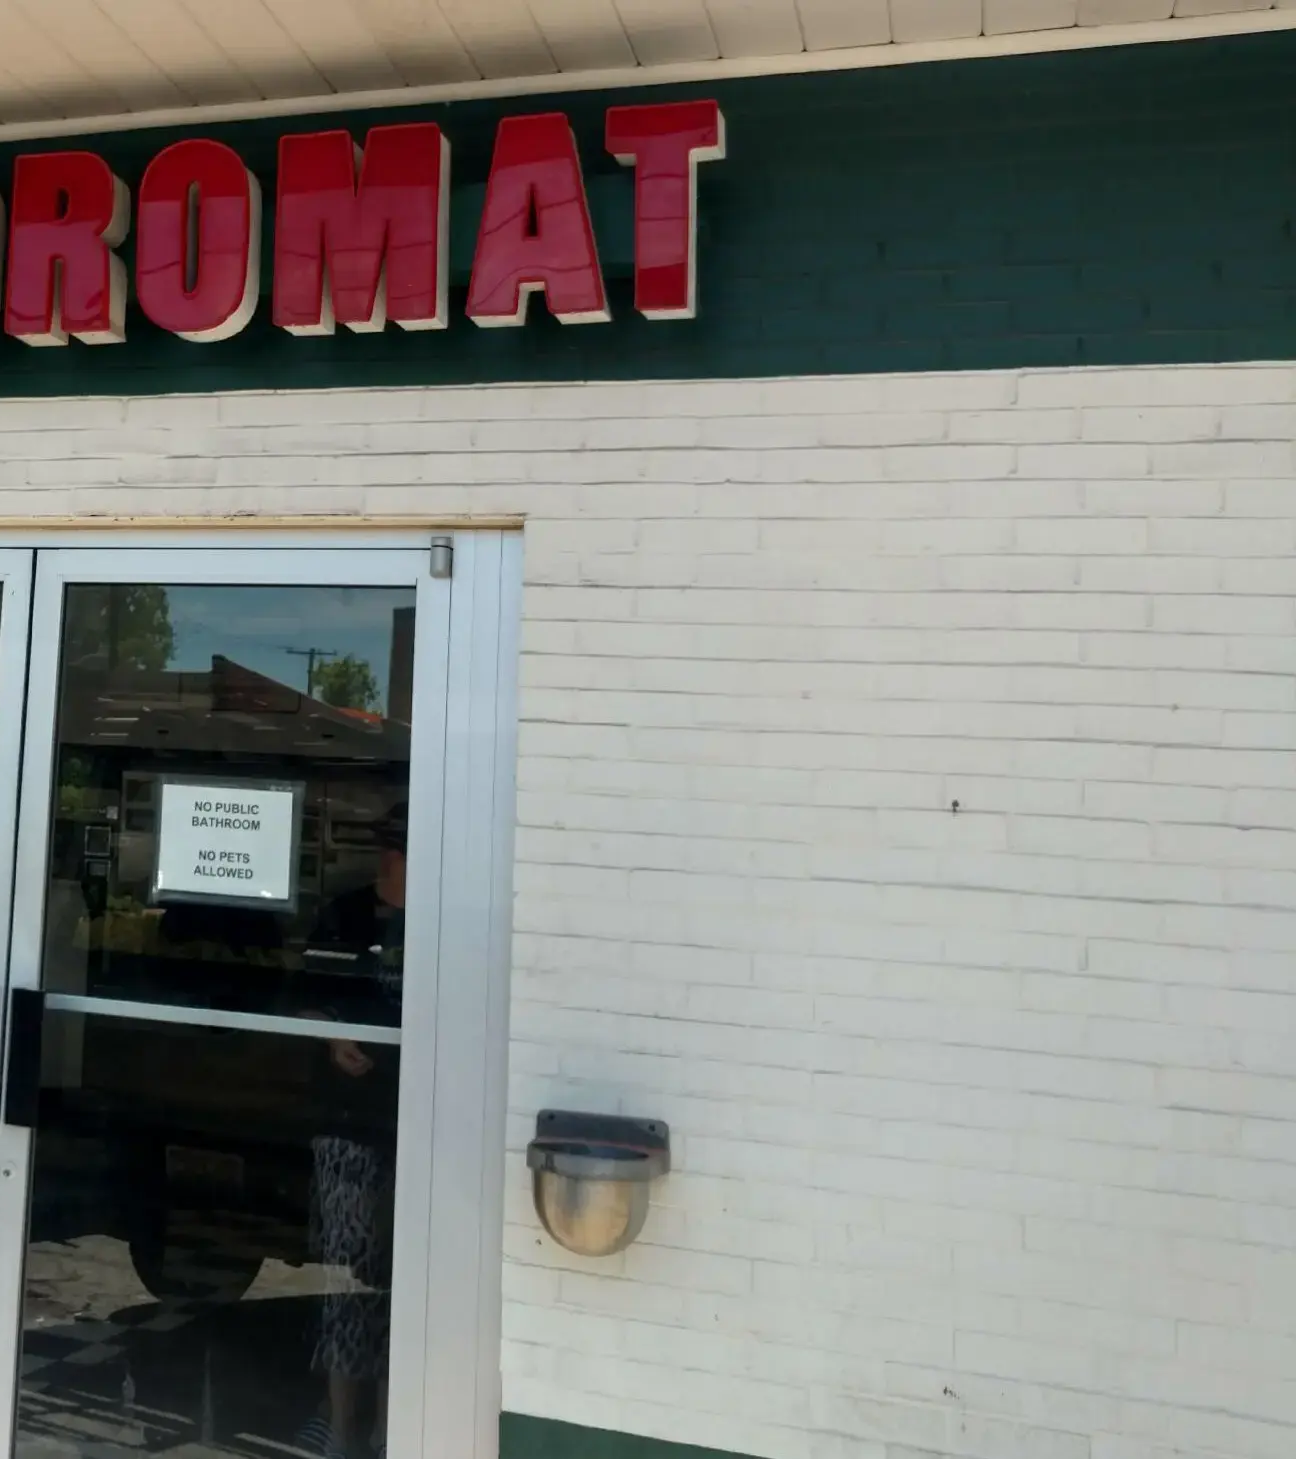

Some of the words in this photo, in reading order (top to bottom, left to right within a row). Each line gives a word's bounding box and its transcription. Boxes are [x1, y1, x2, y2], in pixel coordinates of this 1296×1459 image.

[194, 801, 212, 812] NO
[215, 802, 260, 815] PUBLIC
[191, 816, 261, 831] BATHROOM
[198, 850, 216, 861] NO
[219, 851, 251, 864] PETS
[193, 865, 253, 879] ALLOWED
